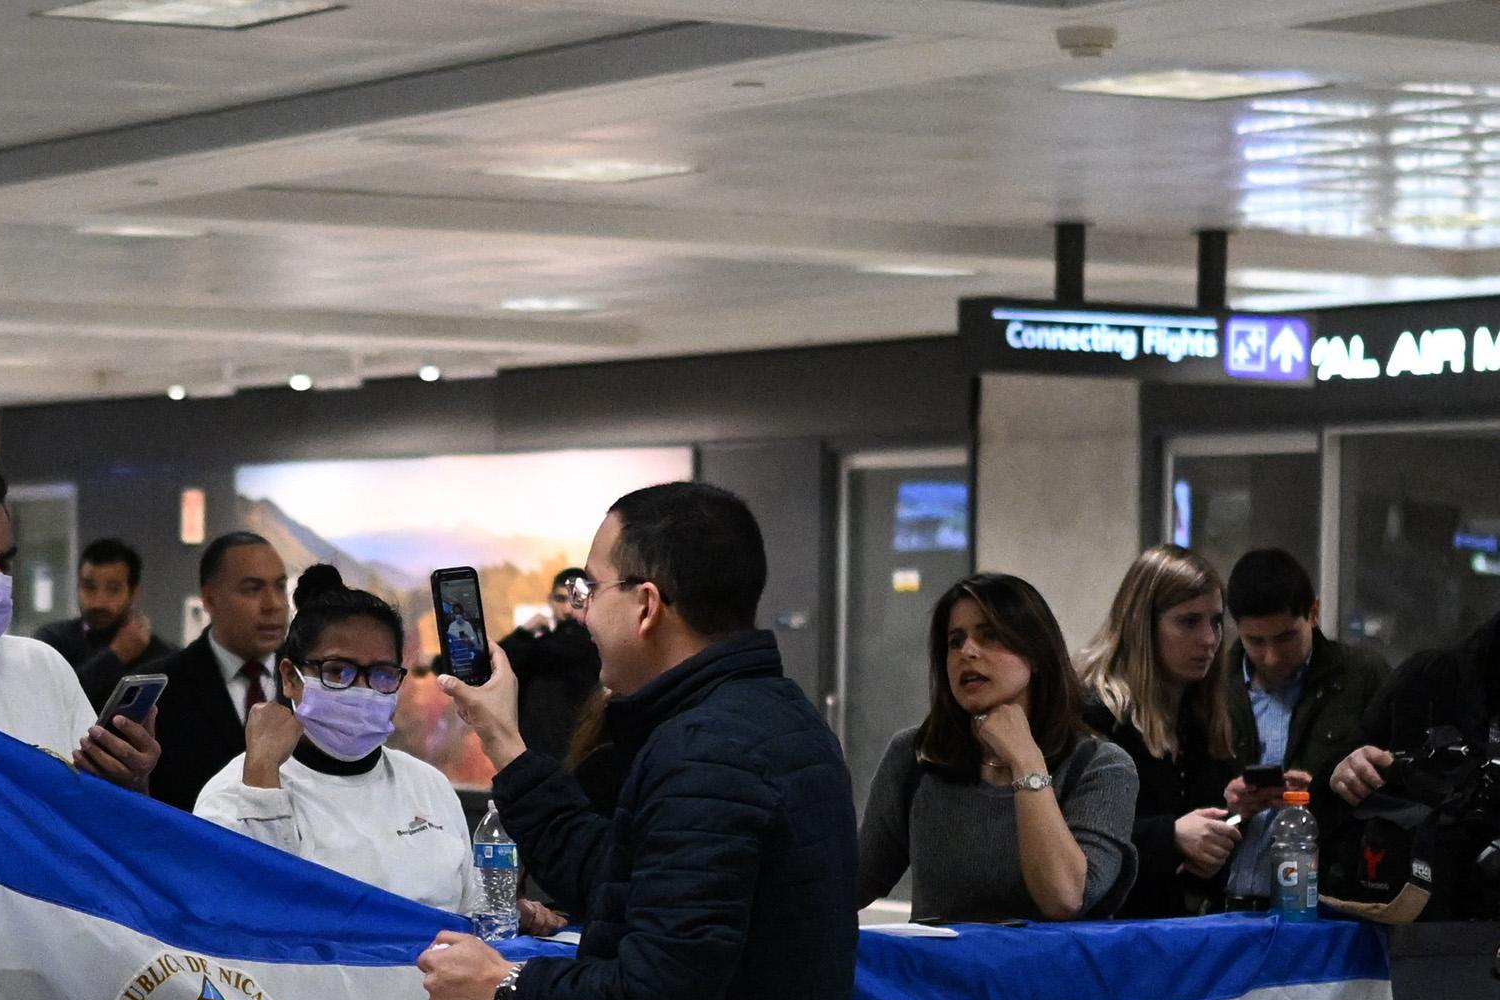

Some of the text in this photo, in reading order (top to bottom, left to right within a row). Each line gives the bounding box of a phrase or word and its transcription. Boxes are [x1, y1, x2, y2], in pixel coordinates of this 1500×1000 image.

[1006, 321, 1219, 363] Connecting Flights
[184, 955, 213, 976] DE
